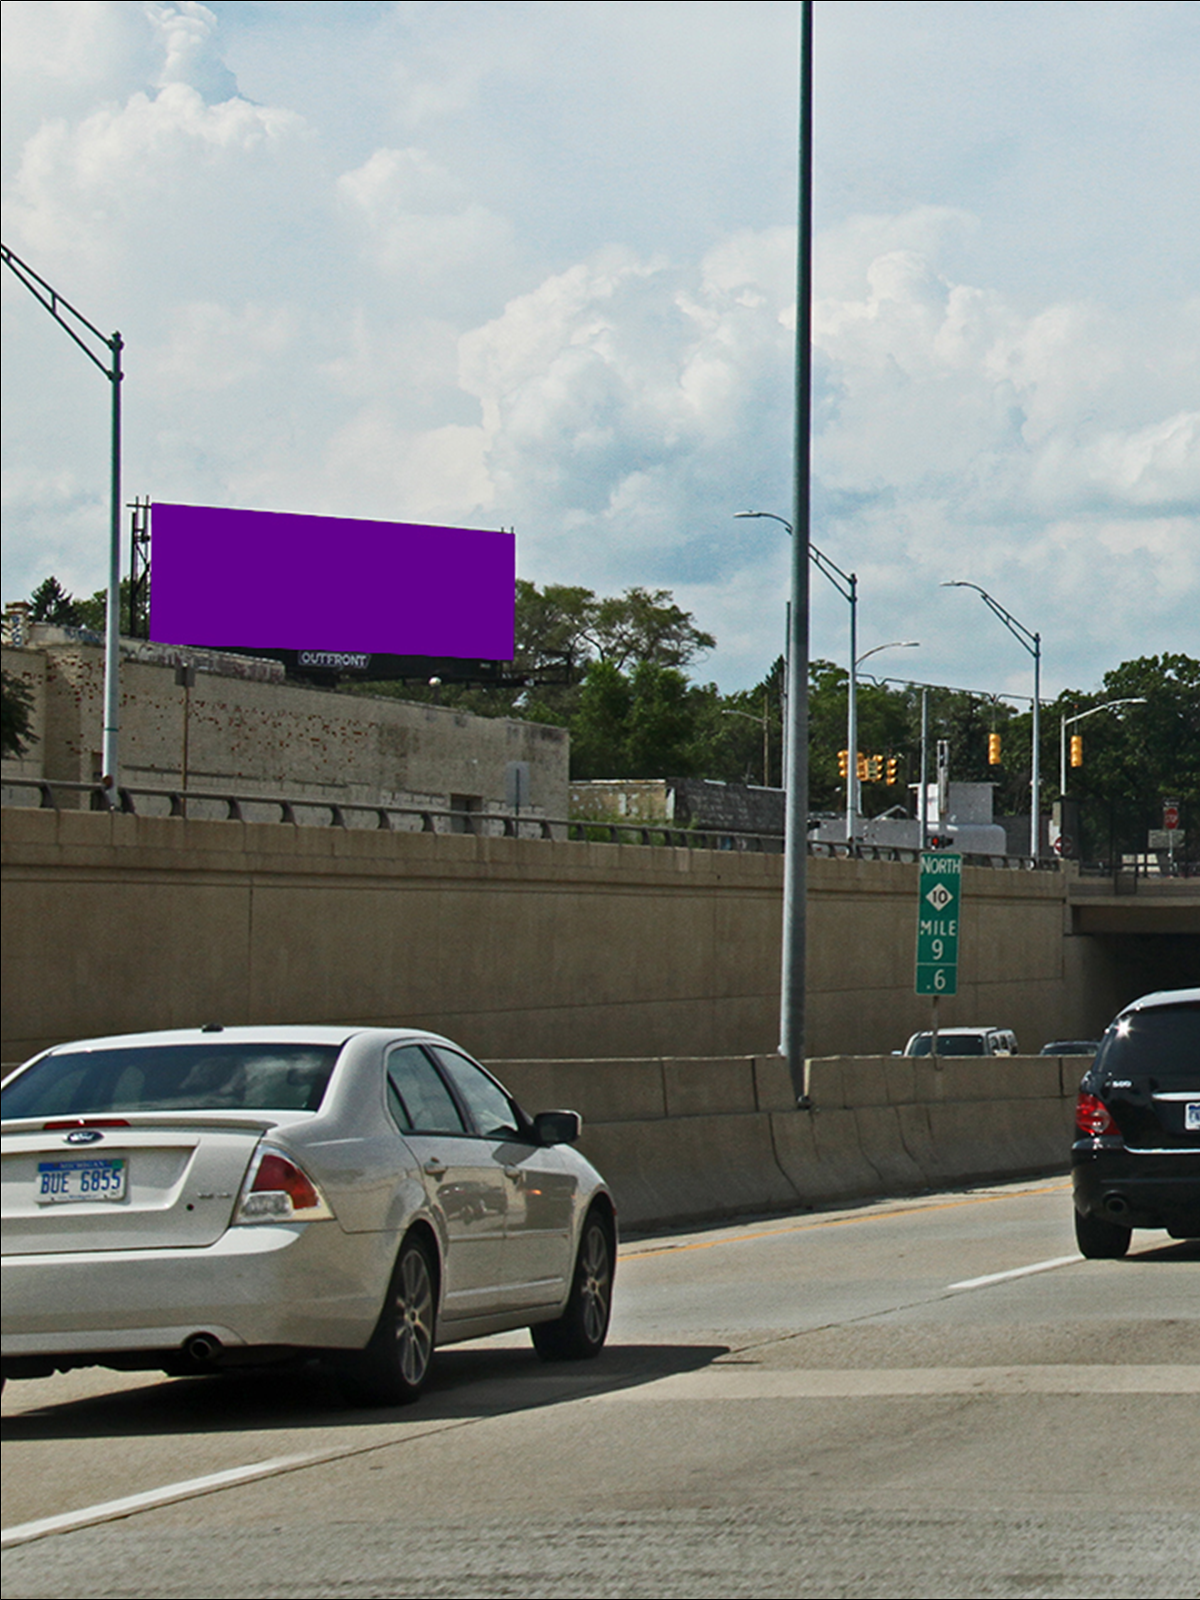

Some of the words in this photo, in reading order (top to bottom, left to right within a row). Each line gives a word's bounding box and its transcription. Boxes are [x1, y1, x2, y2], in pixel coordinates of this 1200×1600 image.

[301, 651, 367, 667] OUTFRONT
[920, 856, 961, 874] NORTH
[932, 889, 949, 904] 10
[920, 920, 957, 936] MILE
[931, 939, 944, 960] 9
[40, 1171, 71, 1195] BUE
[80, 1168, 122, 1192] 6855
